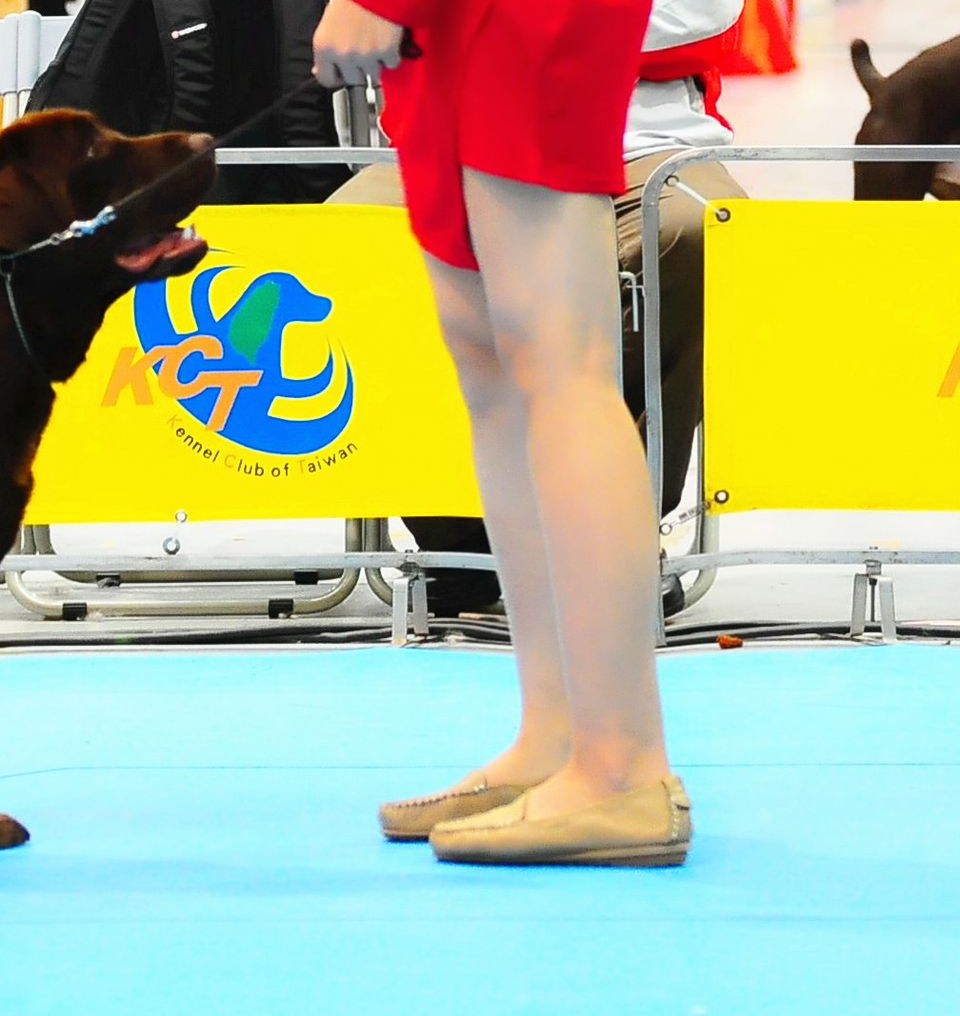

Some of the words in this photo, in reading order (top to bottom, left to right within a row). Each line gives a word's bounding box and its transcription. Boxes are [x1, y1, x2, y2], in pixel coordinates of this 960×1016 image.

[101, 334, 264, 432] KCT
[166, 414, 220, 463] Kennel
[224, 454, 265, 477] Club
[271, 463, 290, 478] of
[296, 441, 359, 474] Taiwan
